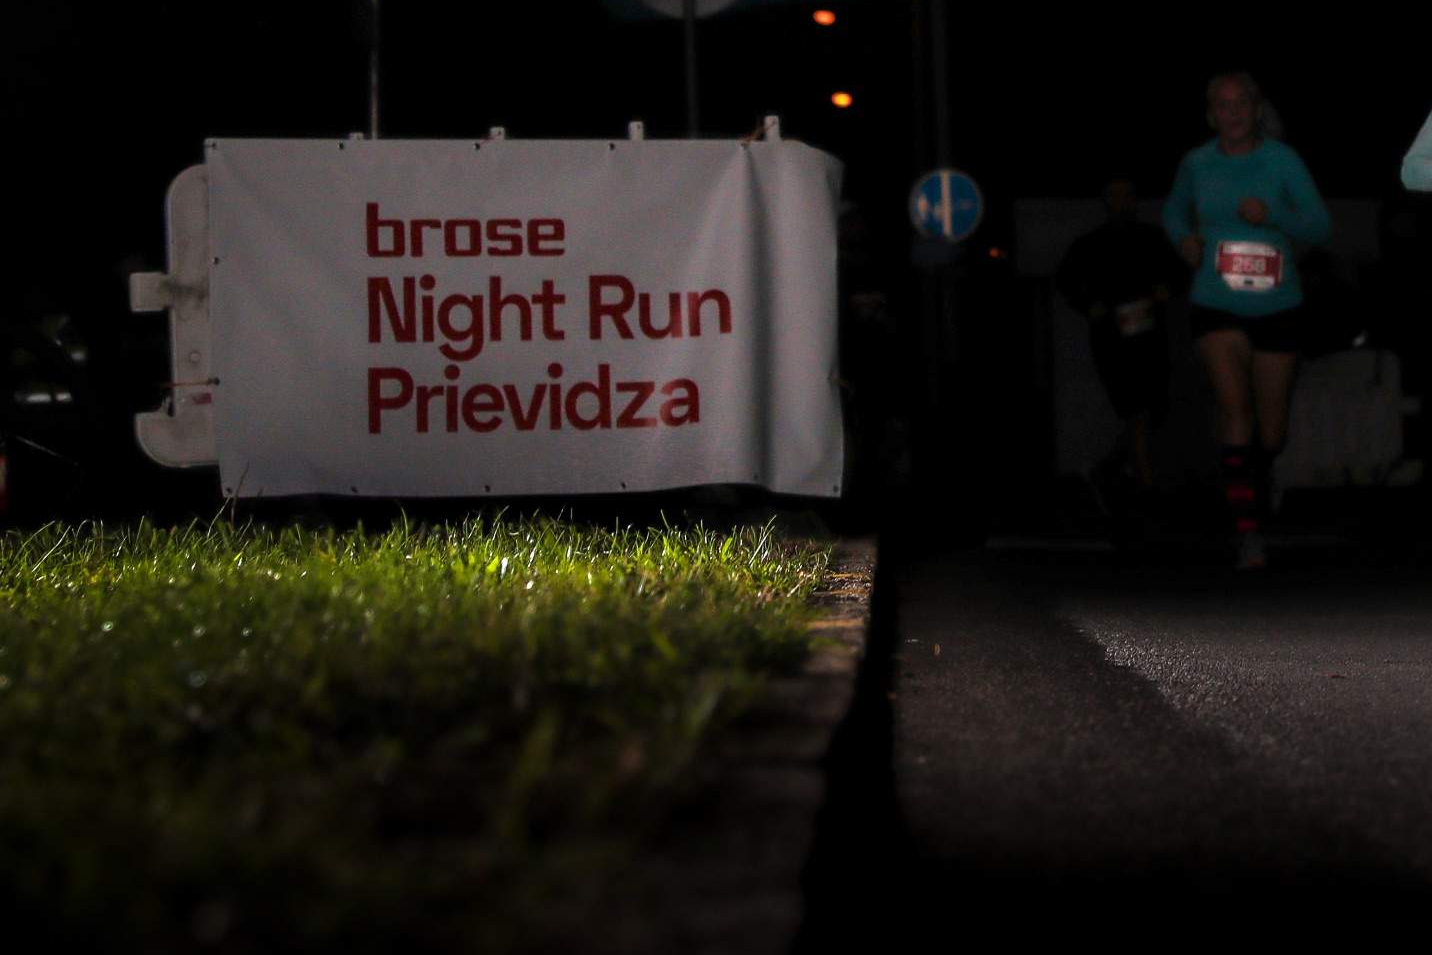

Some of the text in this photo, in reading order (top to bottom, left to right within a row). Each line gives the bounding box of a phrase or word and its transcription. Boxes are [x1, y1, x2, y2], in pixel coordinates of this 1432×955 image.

[367, 203, 566, 257] brose
[370, 276, 733, 361] Night Run
[370, 363, 700, 432] Prievidza
